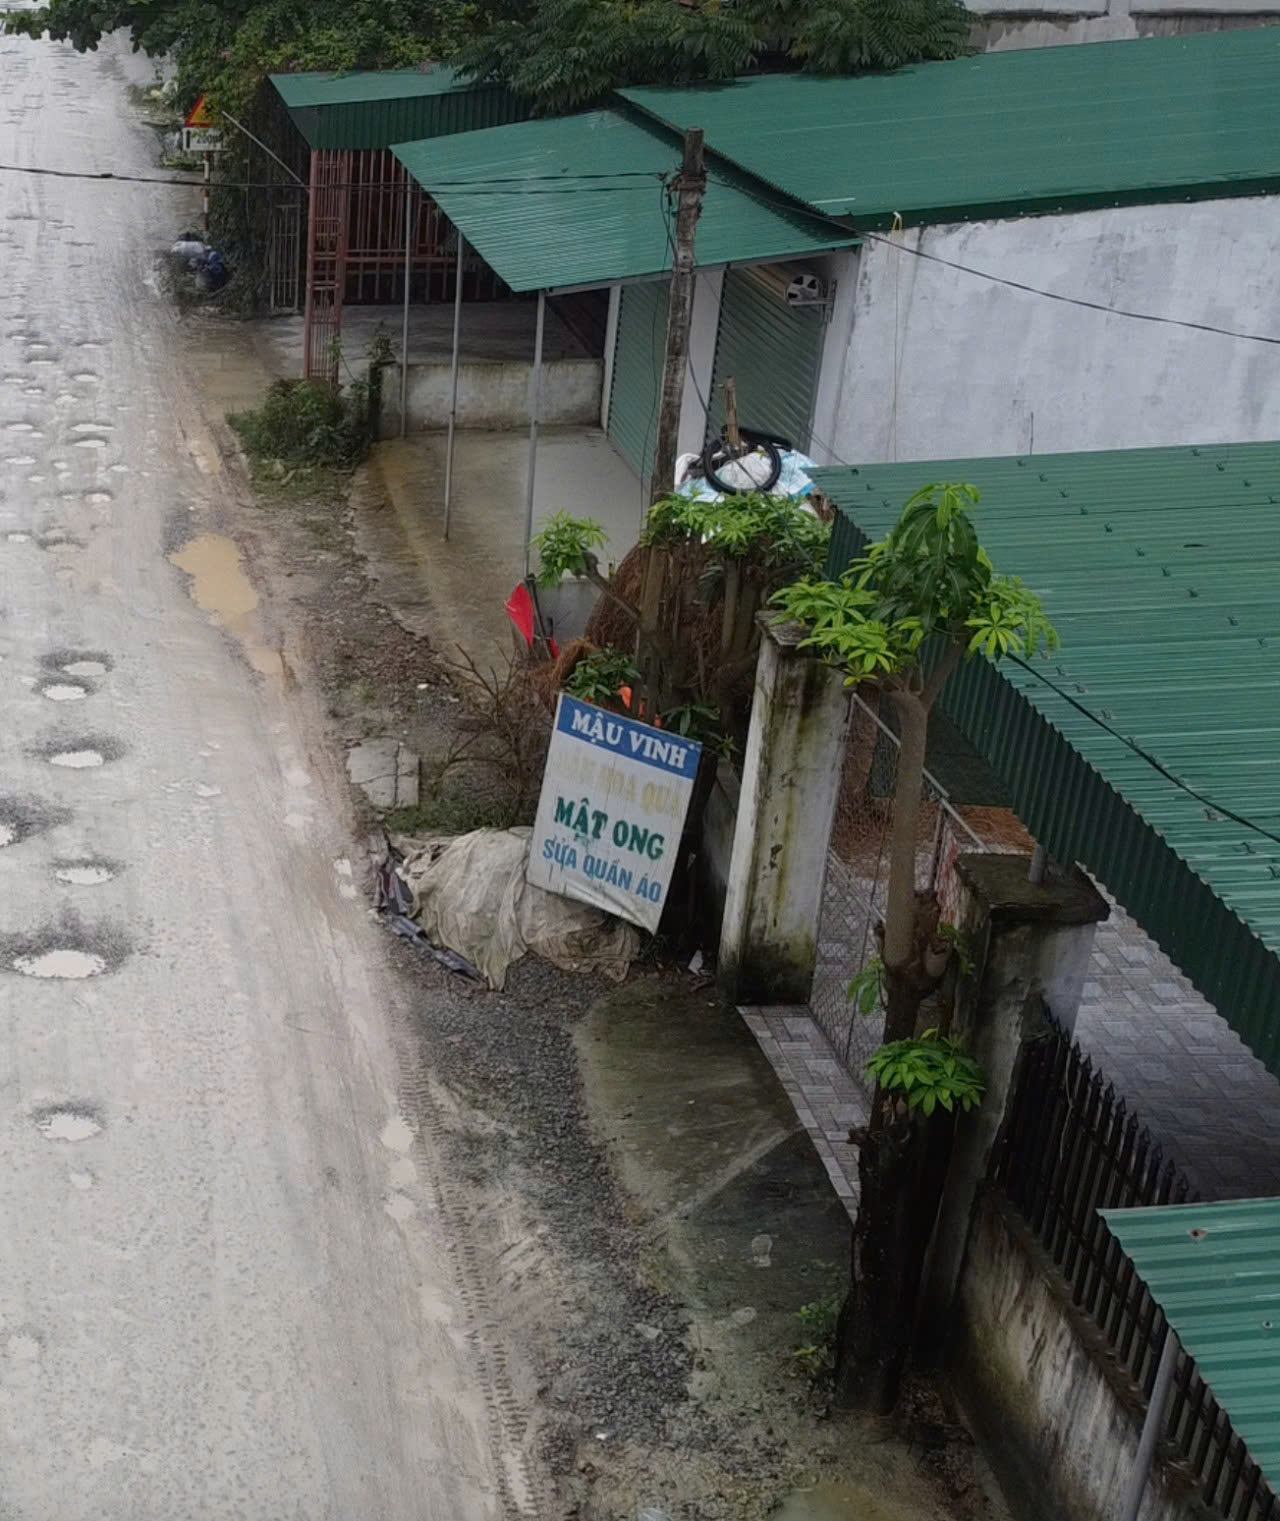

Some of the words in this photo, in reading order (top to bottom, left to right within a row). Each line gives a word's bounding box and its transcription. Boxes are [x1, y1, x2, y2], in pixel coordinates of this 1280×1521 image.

[571, 708, 624, 744] MẬU
[629, 730, 689, 769] VINH
[554, 796, 609, 841] MẬT
[612, 820, 665, 861] ONG
[635, 872, 662, 903] ÁO
